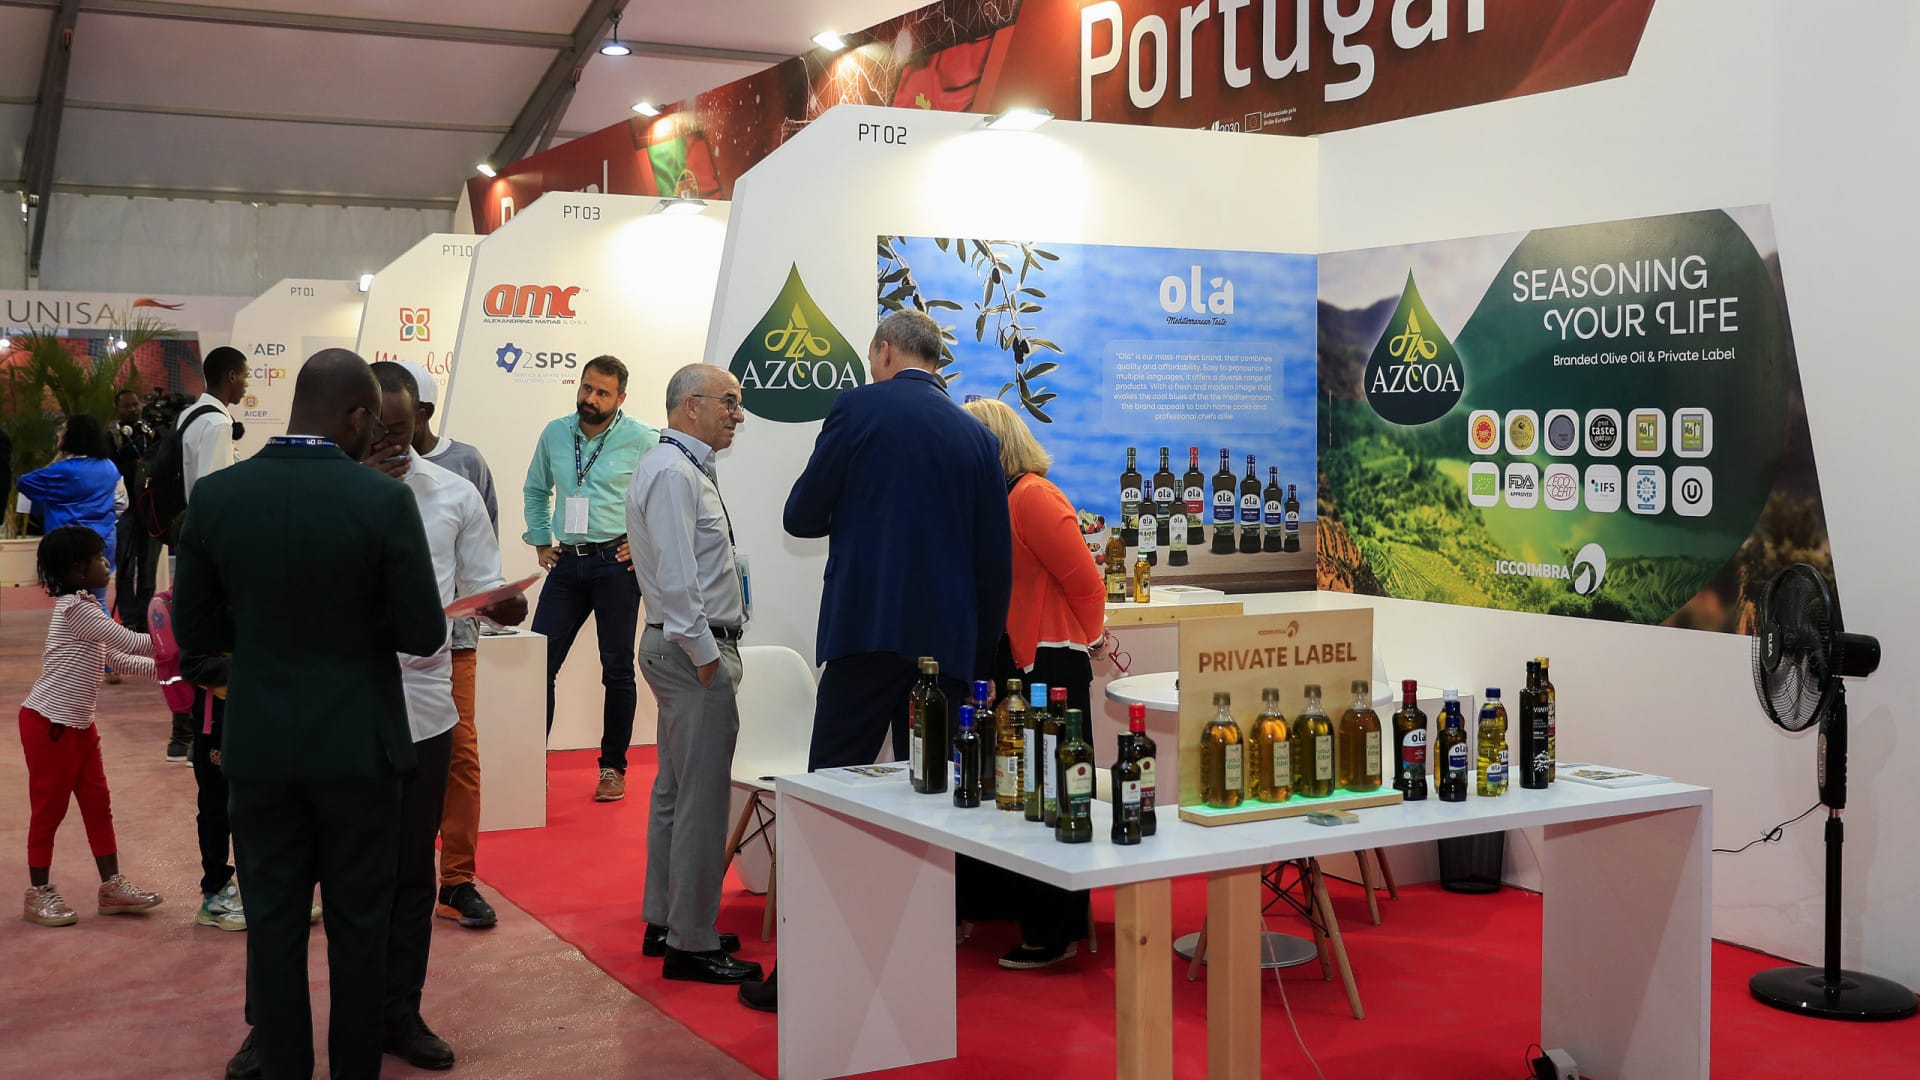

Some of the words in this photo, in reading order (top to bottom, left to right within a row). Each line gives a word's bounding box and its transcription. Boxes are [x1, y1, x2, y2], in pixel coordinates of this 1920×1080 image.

[1512, 254, 1708, 303] SEASONING
[482, 284, 581, 318] amc
[7, 300, 118, 325] UNISA
[1543, 303, 1646, 341] YOUR
[1655, 296, 1739, 335] LIFE
[1166, 316, 1211, 325] Mediterranean
[1212, 317, 1227, 326] Taste
[254, 343, 286, 356] AEP
[1553, 353, 1598, 366] Branded
[1600, 352, 1628, 365] Olive
[1629, 352, 1646, 364] Oil
[1647, 352, 1656, 363] &
[1658, 349, 1699, 363] Private
[1702, 347, 1736, 361] Label
[1116, 363, 1142, 371] quality
[1142, 363, 1156, 371] and
[1220, 363, 1228, 372] to
[1228, 363, 1264, 372] pronounce
[740, 360, 859, 390] AZCOA
[1116, 373, 1144, 381] multiple
[1370, 363, 1461, 394] AZCOA
[1150, 383, 1167, 391] With
[1192, 383, 1206, 391] and
[1208, 383, 1234, 391] modern
[1138, 392, 1151, 400] the
[1152, 392, 1168, 400] cool
[1120, 402, 1134, 410] the
[1134, 402, 1156, 410] brand
[1156, 402, 1184, 410] appeals
[1186, 402, 1194, 410] to
[244, 410, 268, 418] AICEP
[1154, 412, 1197, 420] professional
[1591, 426, 1615, 436] taste
[1508, 474, 1535, 489] FDA
[1600, 482, 1615, 492] IFS
[1495, 560, 1570, 580] JCCOIMBRA
[1198, 646, 1288, 674] PRIVATE
[1294, 642, 1358, 667] LABEL
